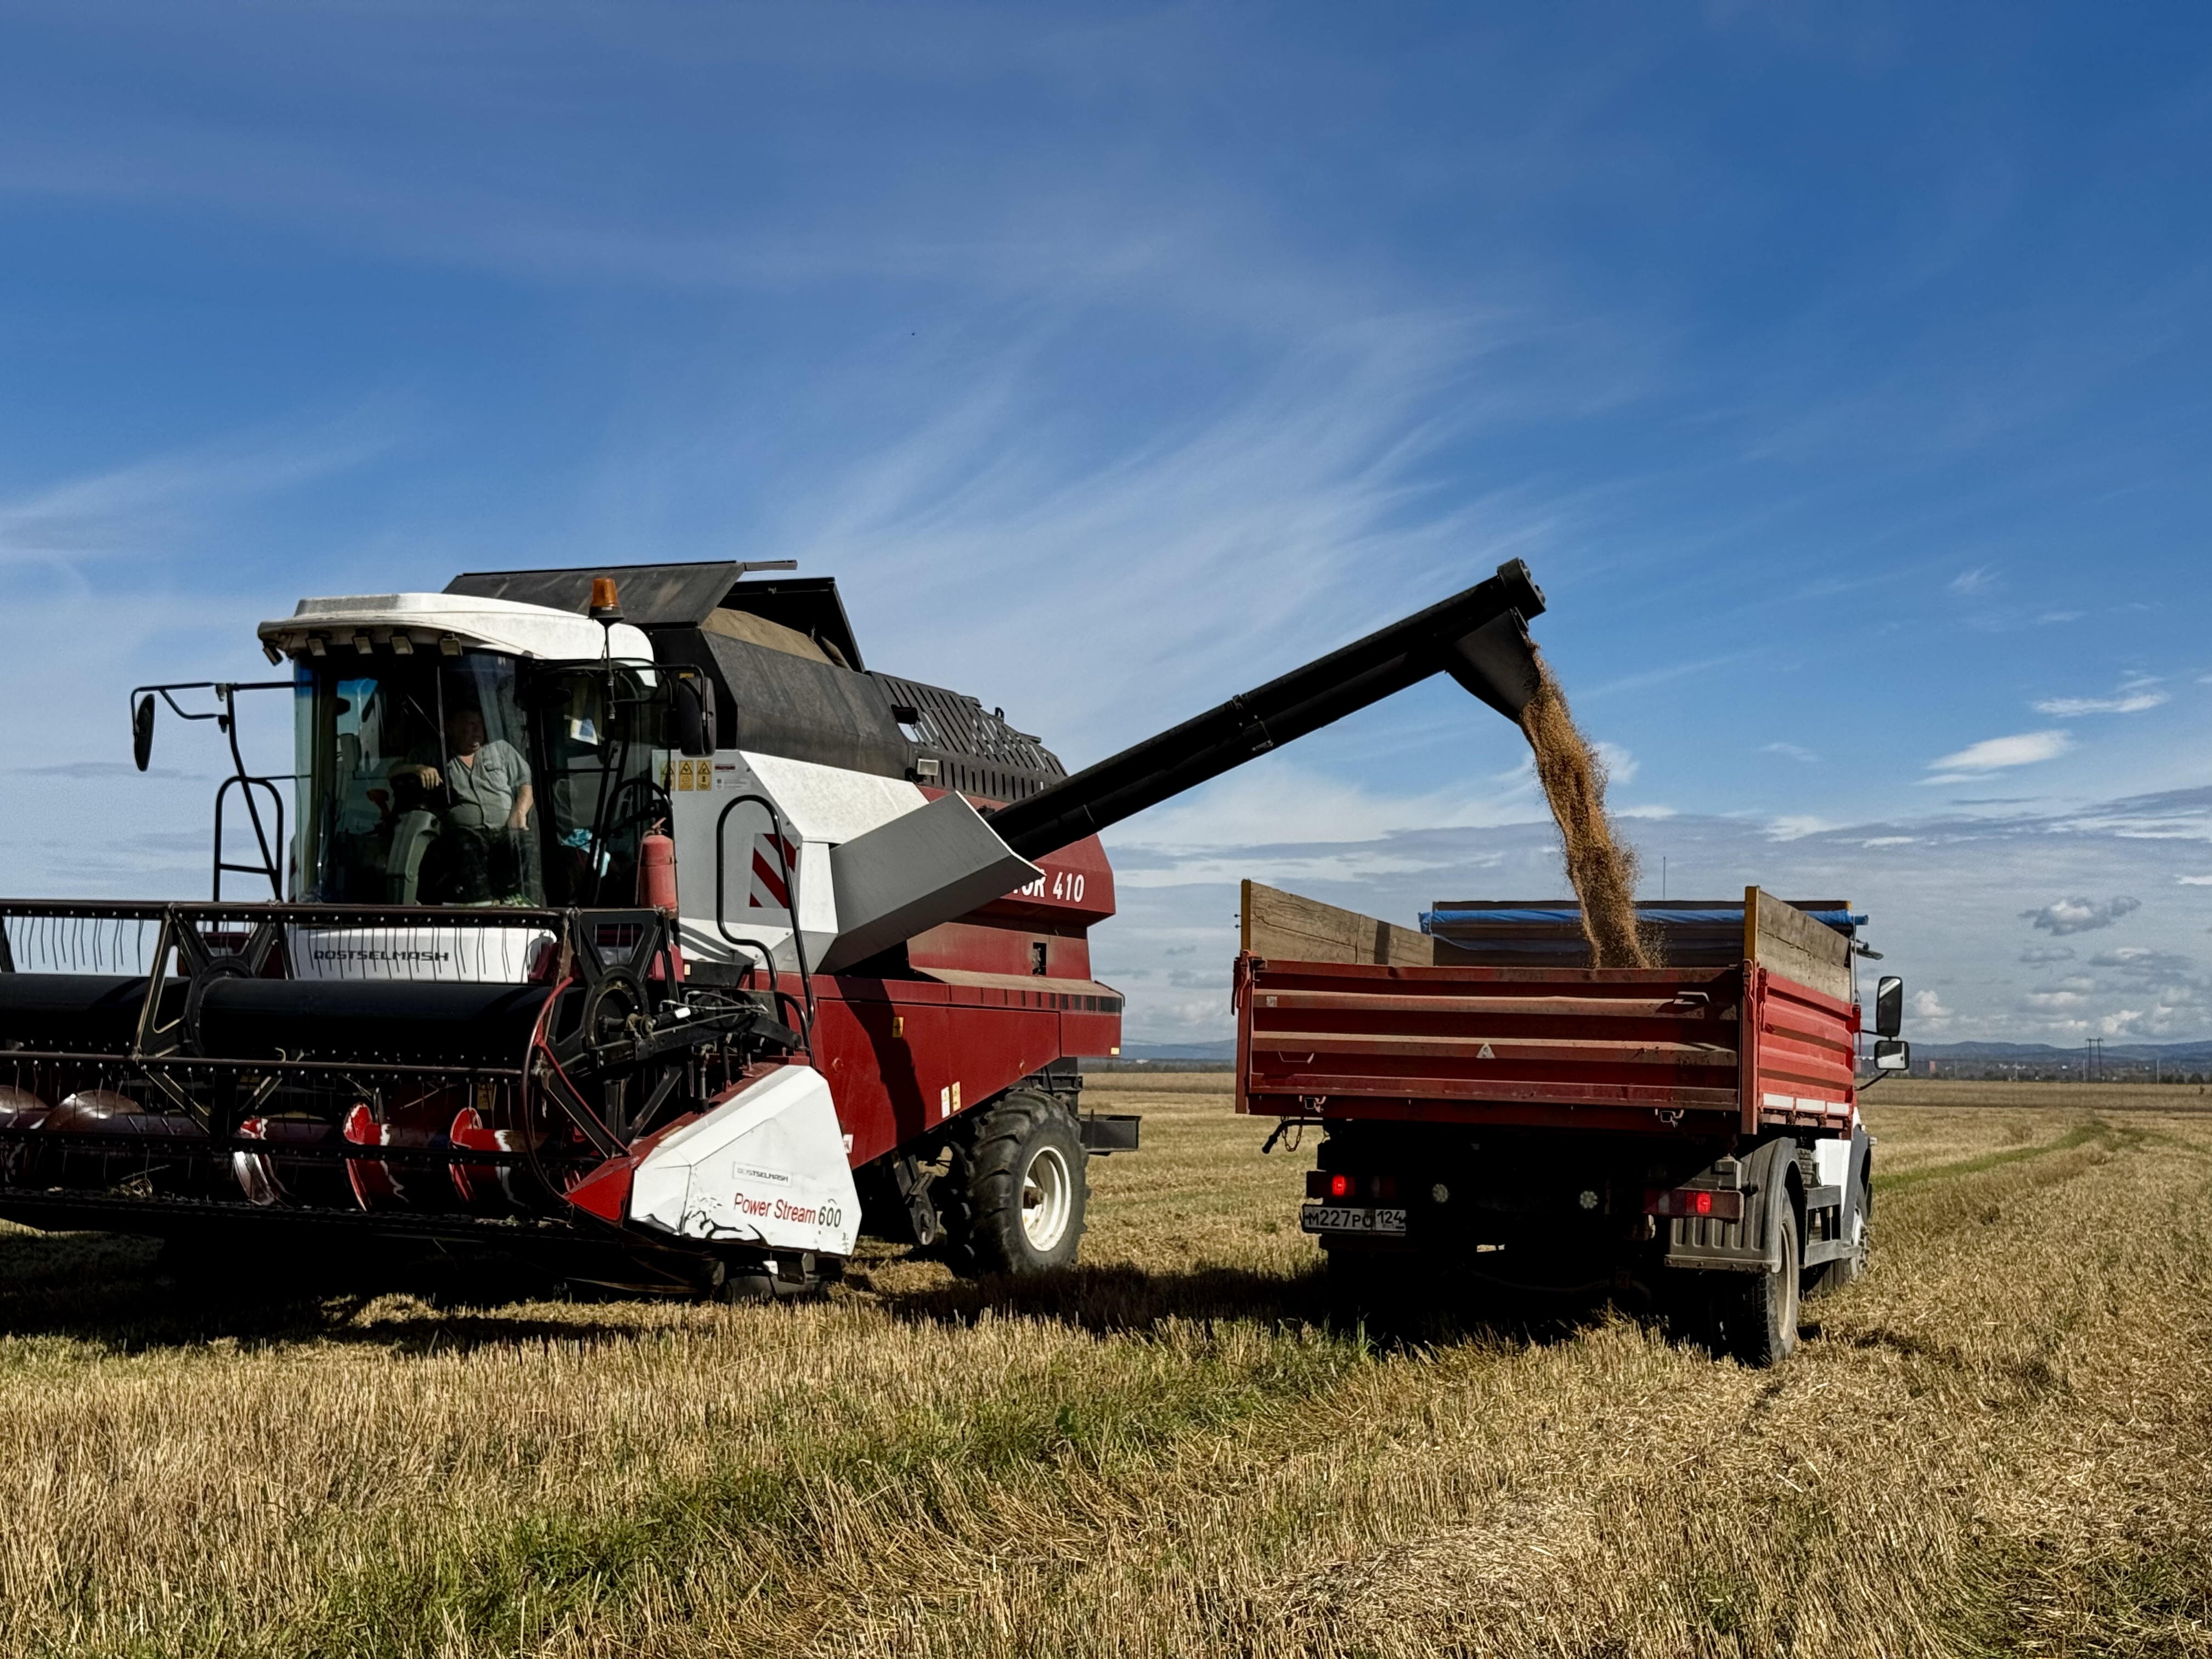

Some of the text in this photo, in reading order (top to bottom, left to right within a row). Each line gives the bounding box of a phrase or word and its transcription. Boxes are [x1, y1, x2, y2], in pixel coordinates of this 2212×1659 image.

[1053, 872, 1084, 902] 410
[314, 950, 449, 961] ROSTSELMASH
[733, 1193, 842, 1228] Power Stream 600
[1377, 1210, 1403, 1224] 124
